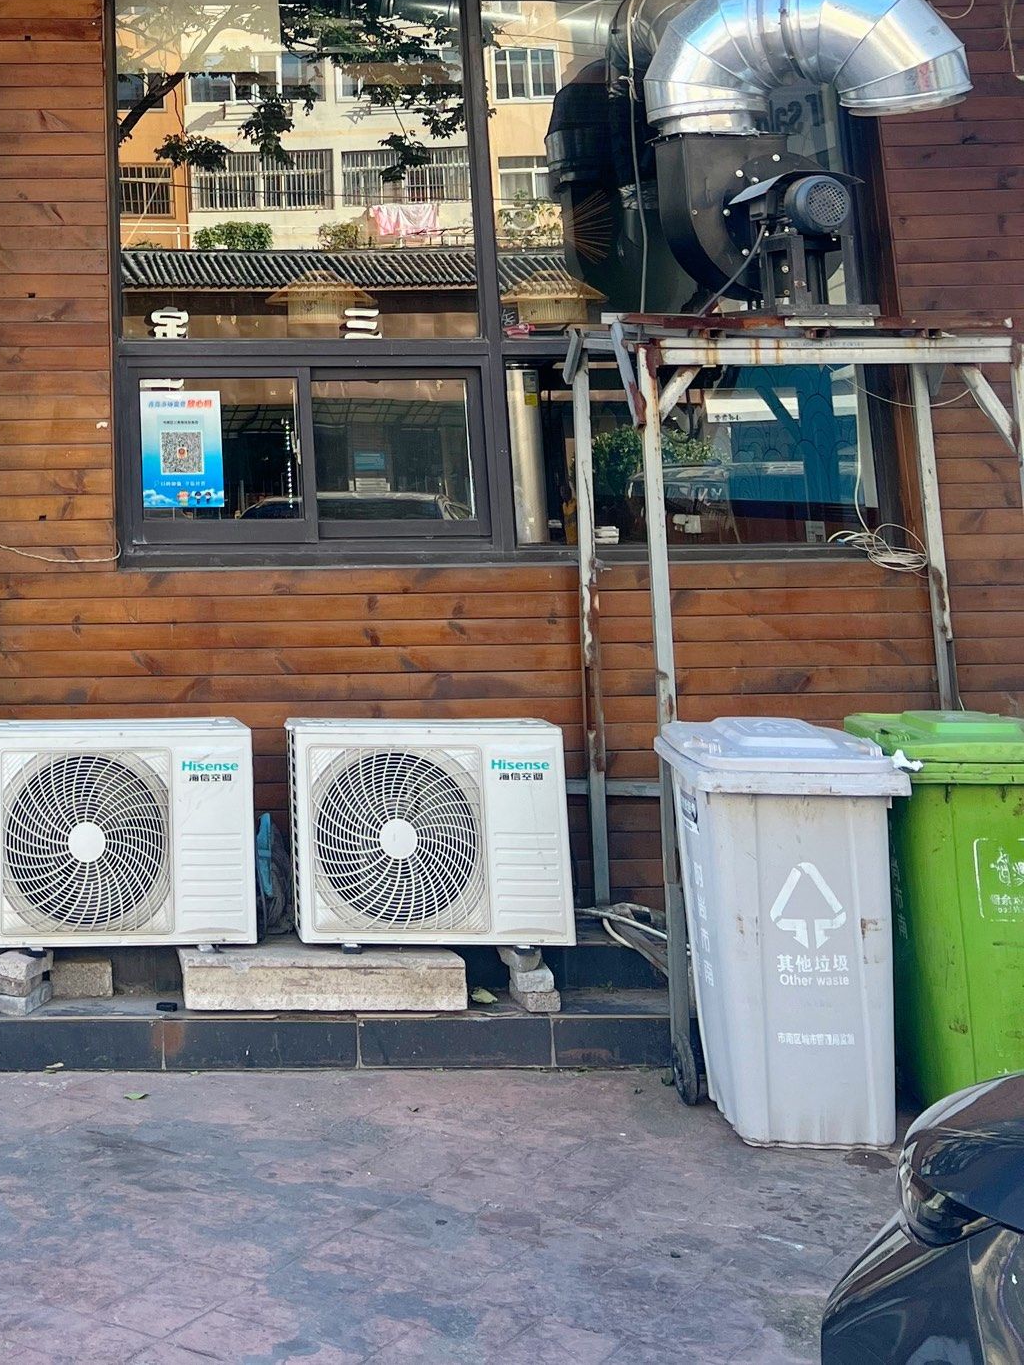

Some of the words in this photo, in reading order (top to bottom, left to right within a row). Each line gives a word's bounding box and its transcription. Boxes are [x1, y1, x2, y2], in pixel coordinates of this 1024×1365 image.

[181, 761, 239, 771] Hisense
[491, 758, 550, 770] Hisense
[188, 774, 232, 782] 海信空调
[499, 772, 544, 780] 海信空调
[777, 954, 849, 973] 其他垃圾
[780, 974, 812, 986] Other
[816, 975, 850, 986] waste
